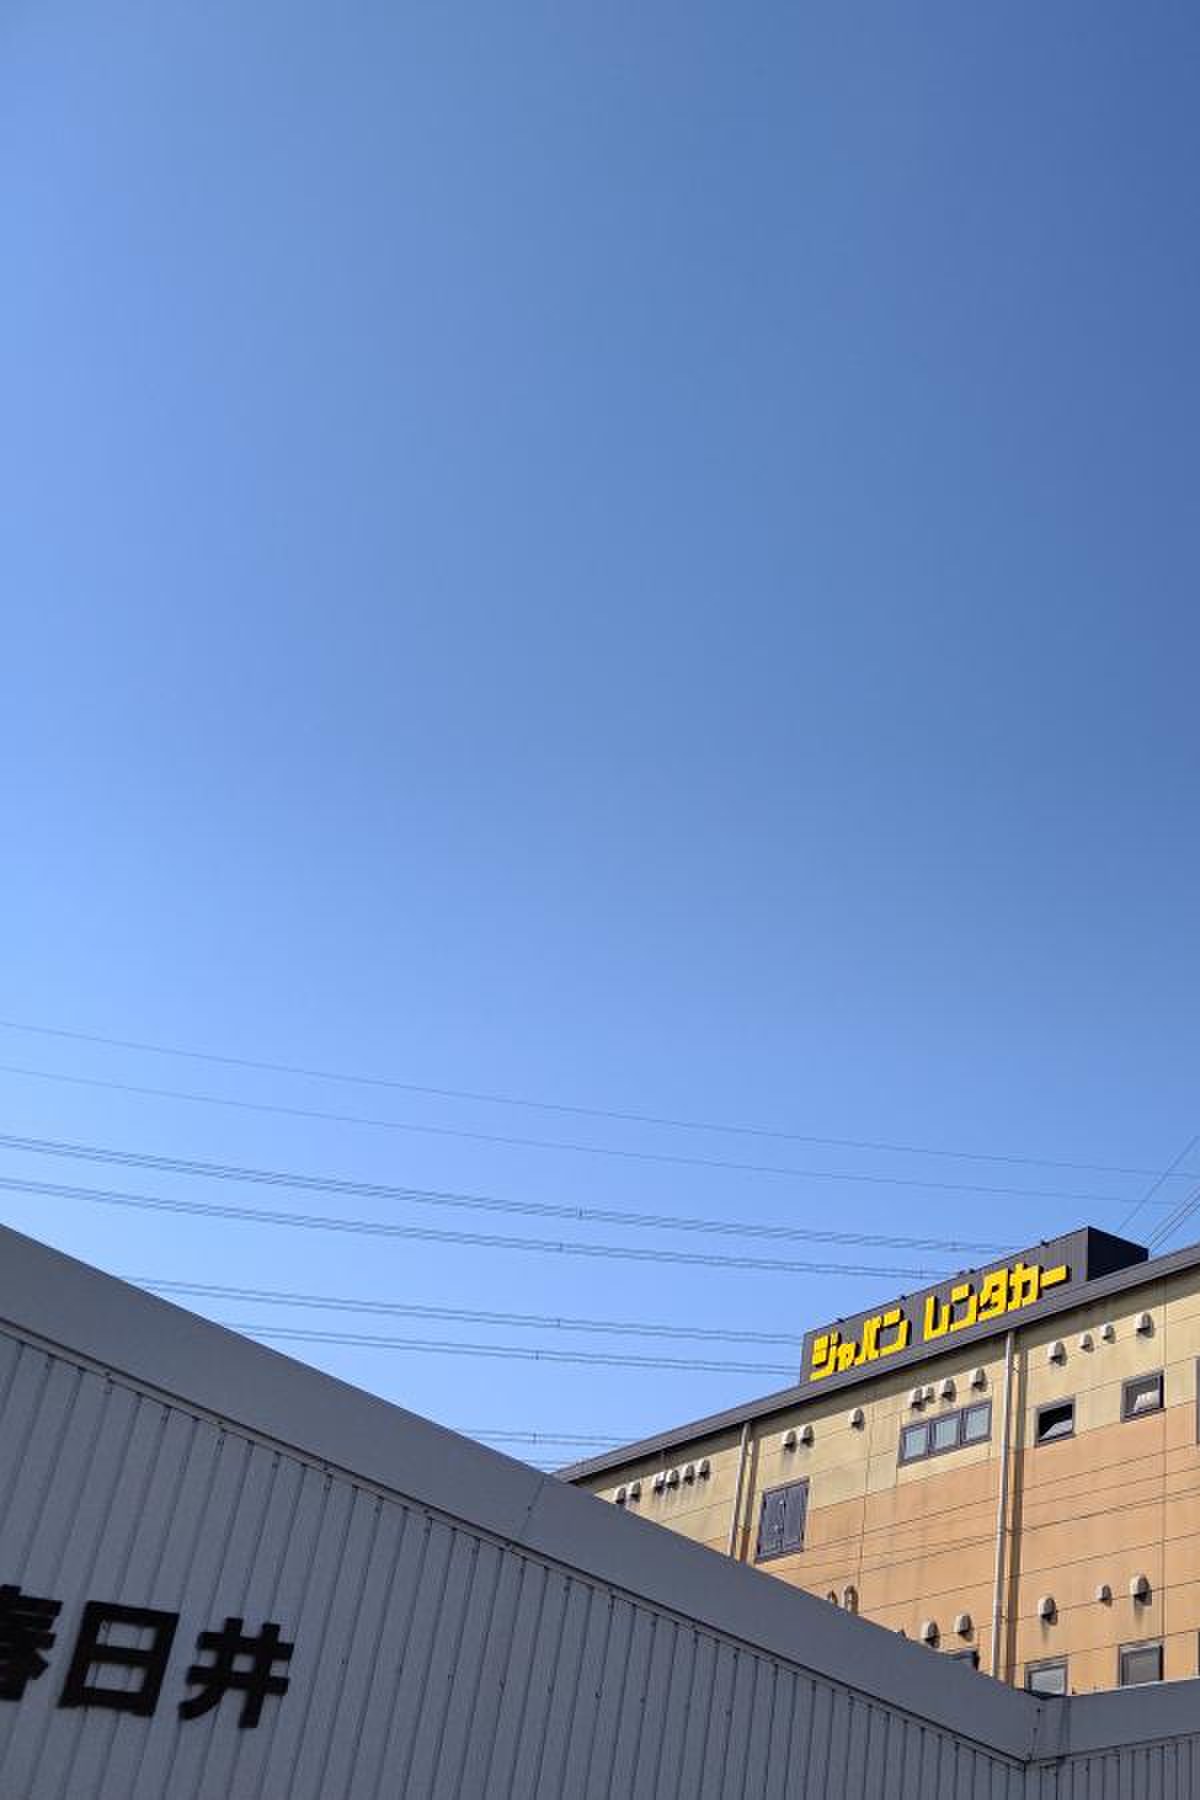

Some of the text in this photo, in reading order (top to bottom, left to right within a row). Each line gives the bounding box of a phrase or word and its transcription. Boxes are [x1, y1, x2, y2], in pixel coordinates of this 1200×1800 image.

[923, 1263, 1067, 1341] レンタカー
